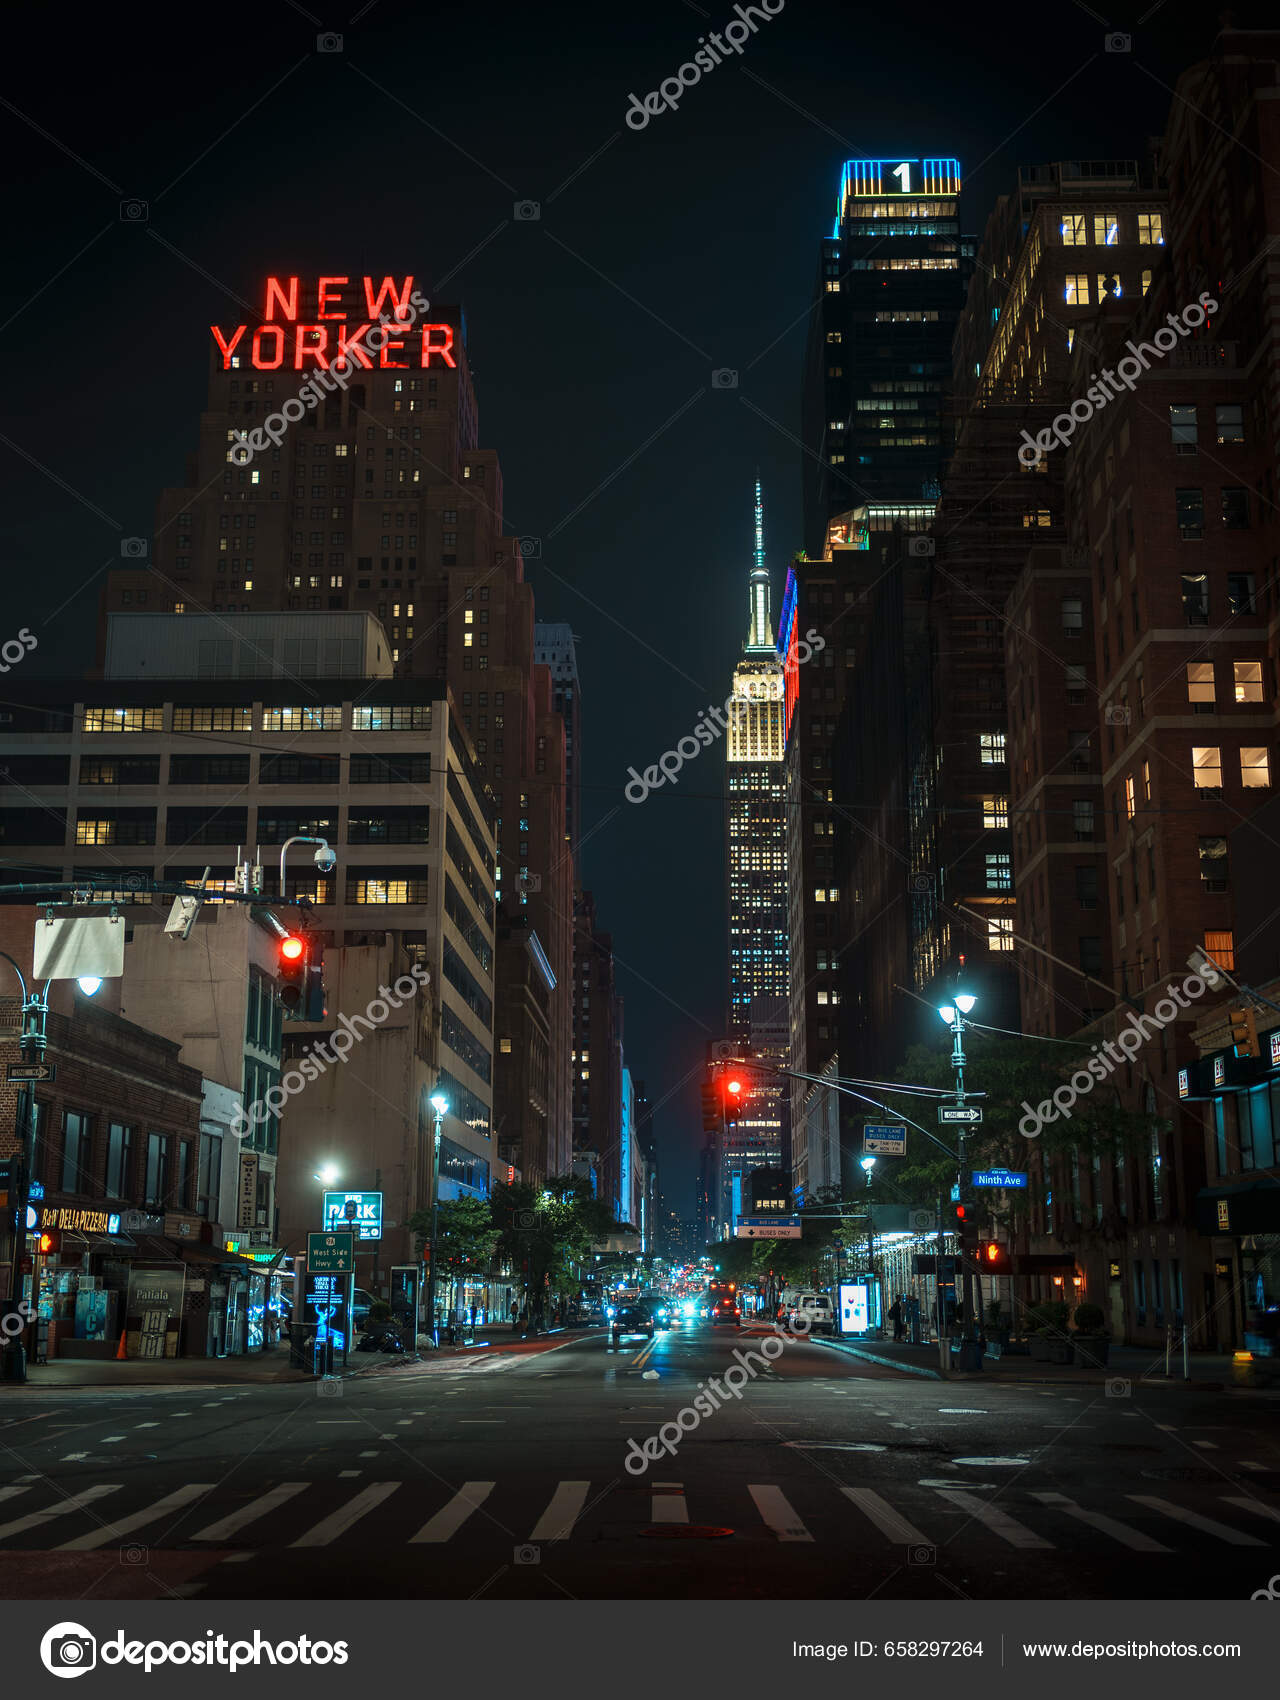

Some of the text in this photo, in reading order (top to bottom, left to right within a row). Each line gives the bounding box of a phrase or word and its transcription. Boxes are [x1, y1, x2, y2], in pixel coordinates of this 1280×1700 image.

[891, 163, 911, 193] 1
[264, 276, 415, 321] NEW
[211, 323, 457, 370] YORKER
[978, 1175, 1021, 1185] Ninth Ave
[315, 1260, 331, 1268] Hwy
[136, 1288, 169, 1300] Patiala
